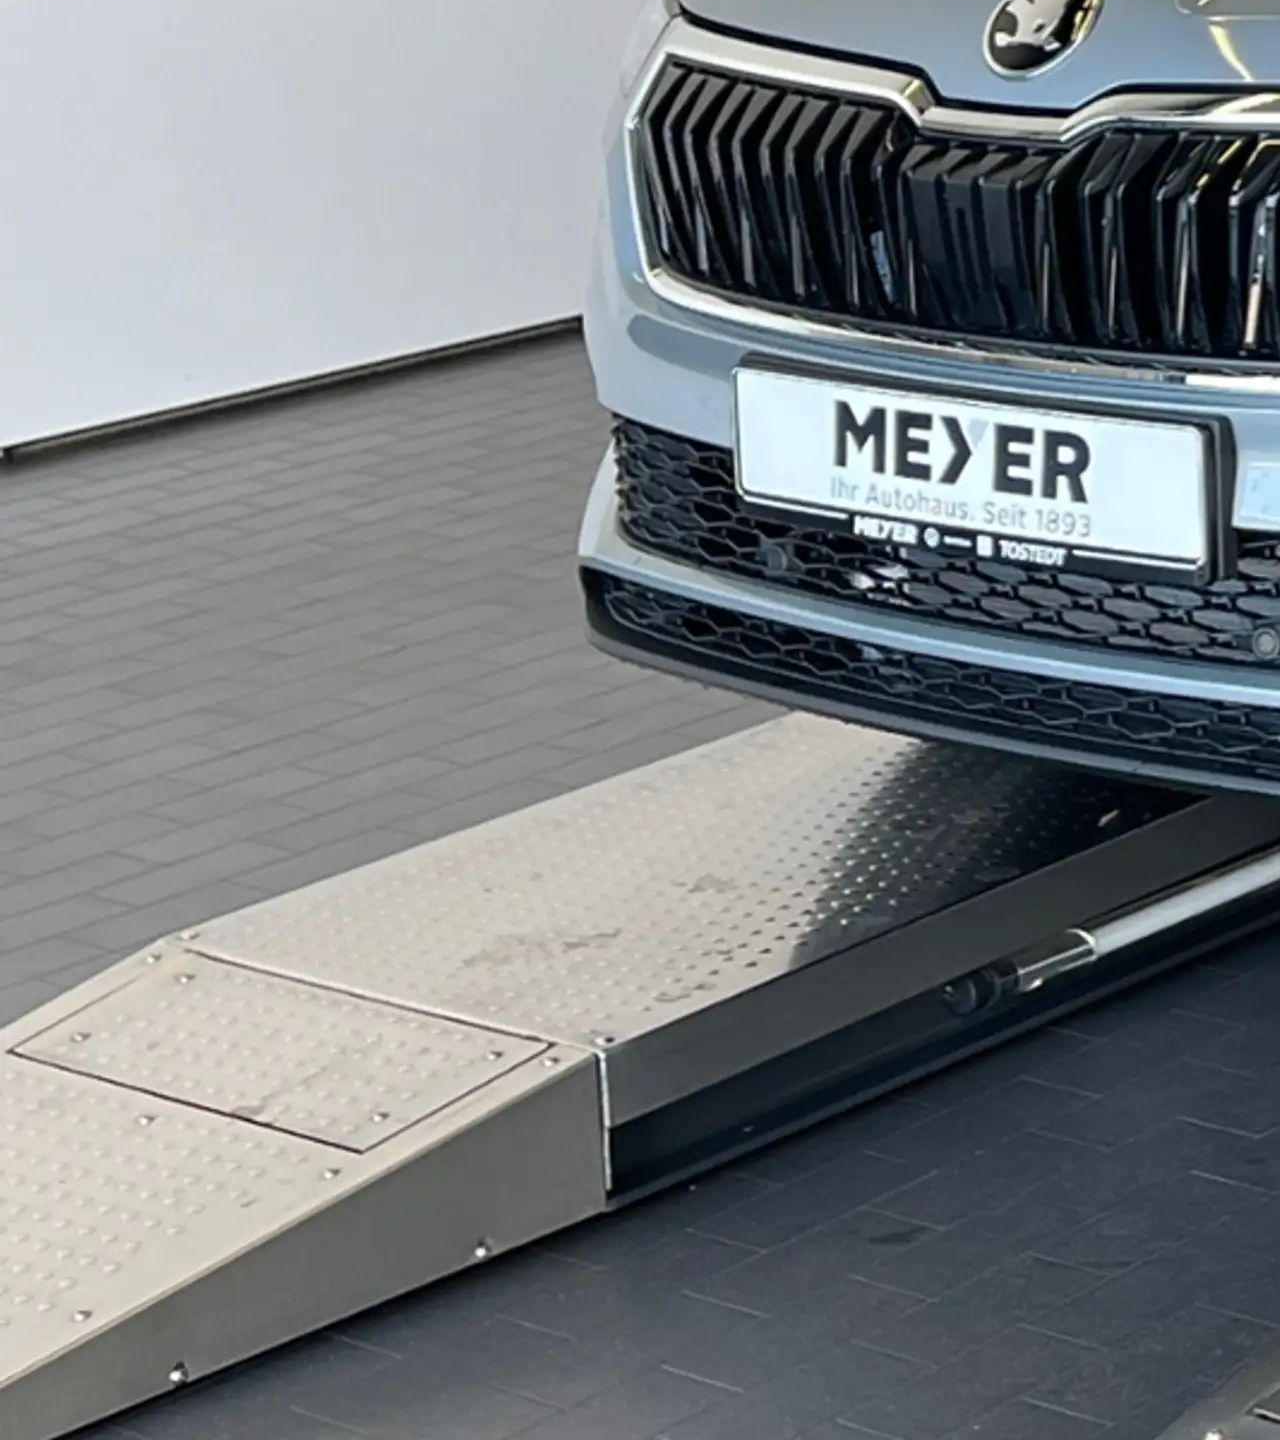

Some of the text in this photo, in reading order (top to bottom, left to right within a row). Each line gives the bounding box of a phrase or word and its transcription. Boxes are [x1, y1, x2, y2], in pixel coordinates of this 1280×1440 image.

[834, 400, 1091, 504] MEYER
[830, 475, 1092, 539] Ihr Autohaus. Seit 1893
[853, 515, 919, 546] MEYER
[999, 539, 1068, 567] TOSTEDT
